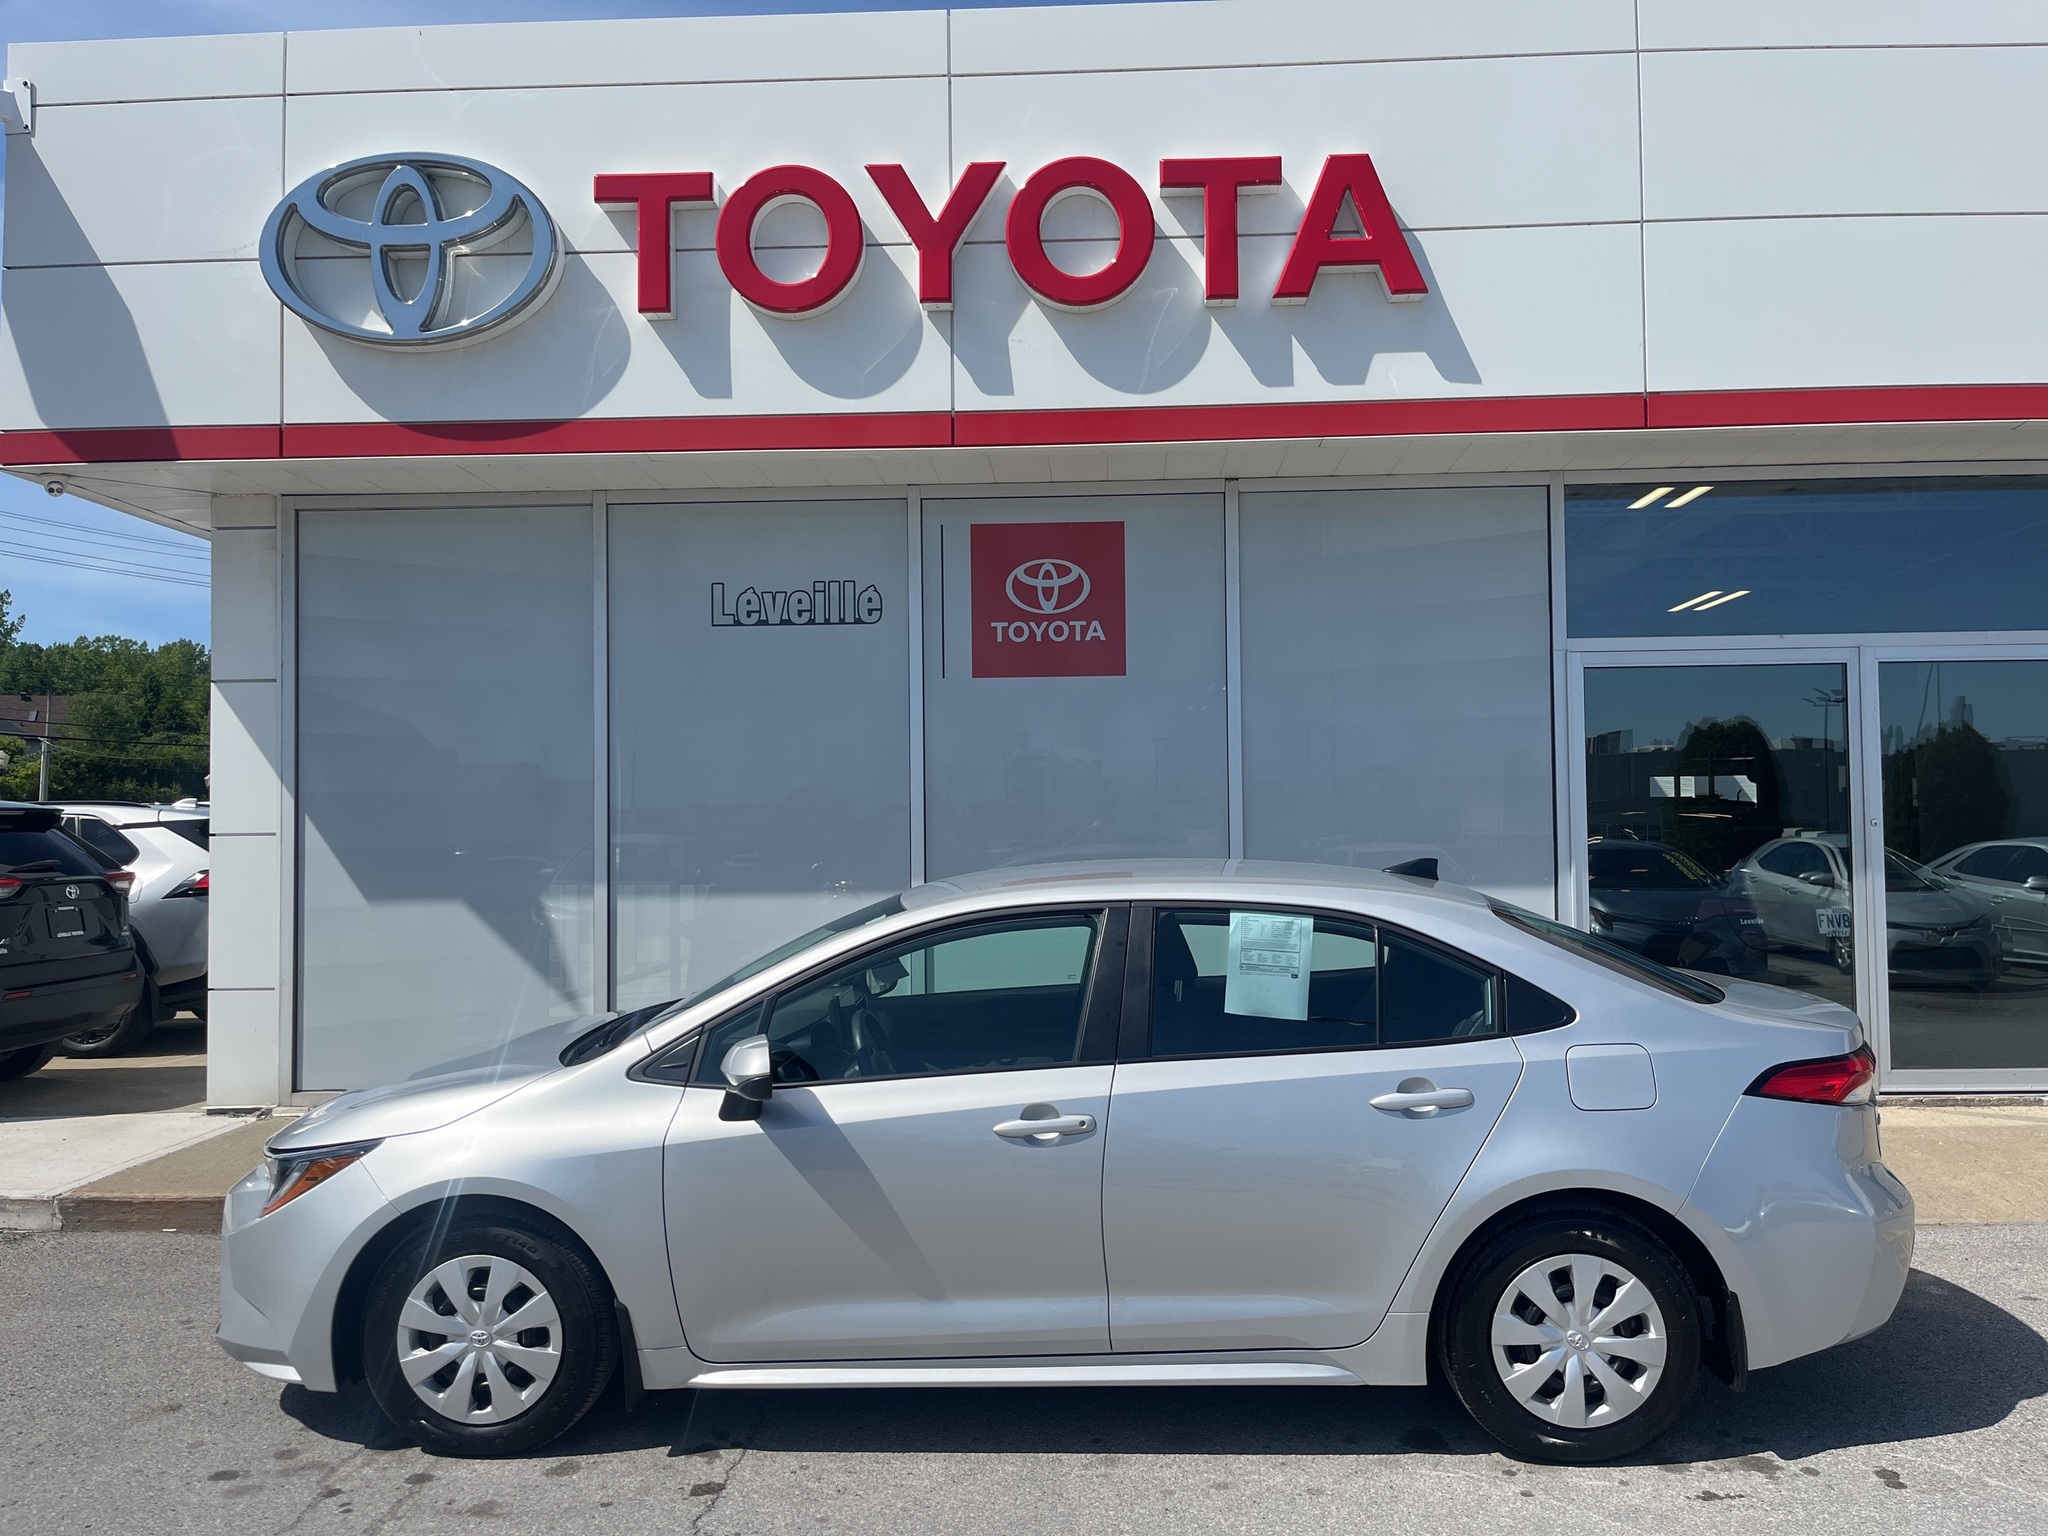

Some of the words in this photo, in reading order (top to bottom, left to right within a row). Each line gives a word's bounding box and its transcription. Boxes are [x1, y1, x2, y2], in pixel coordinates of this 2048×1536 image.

[594, 153, 1429, 318] TOYOTA
[711, 580, 883, 626] Léveillé
[990, 620, 1107, 643] TOYOTA
